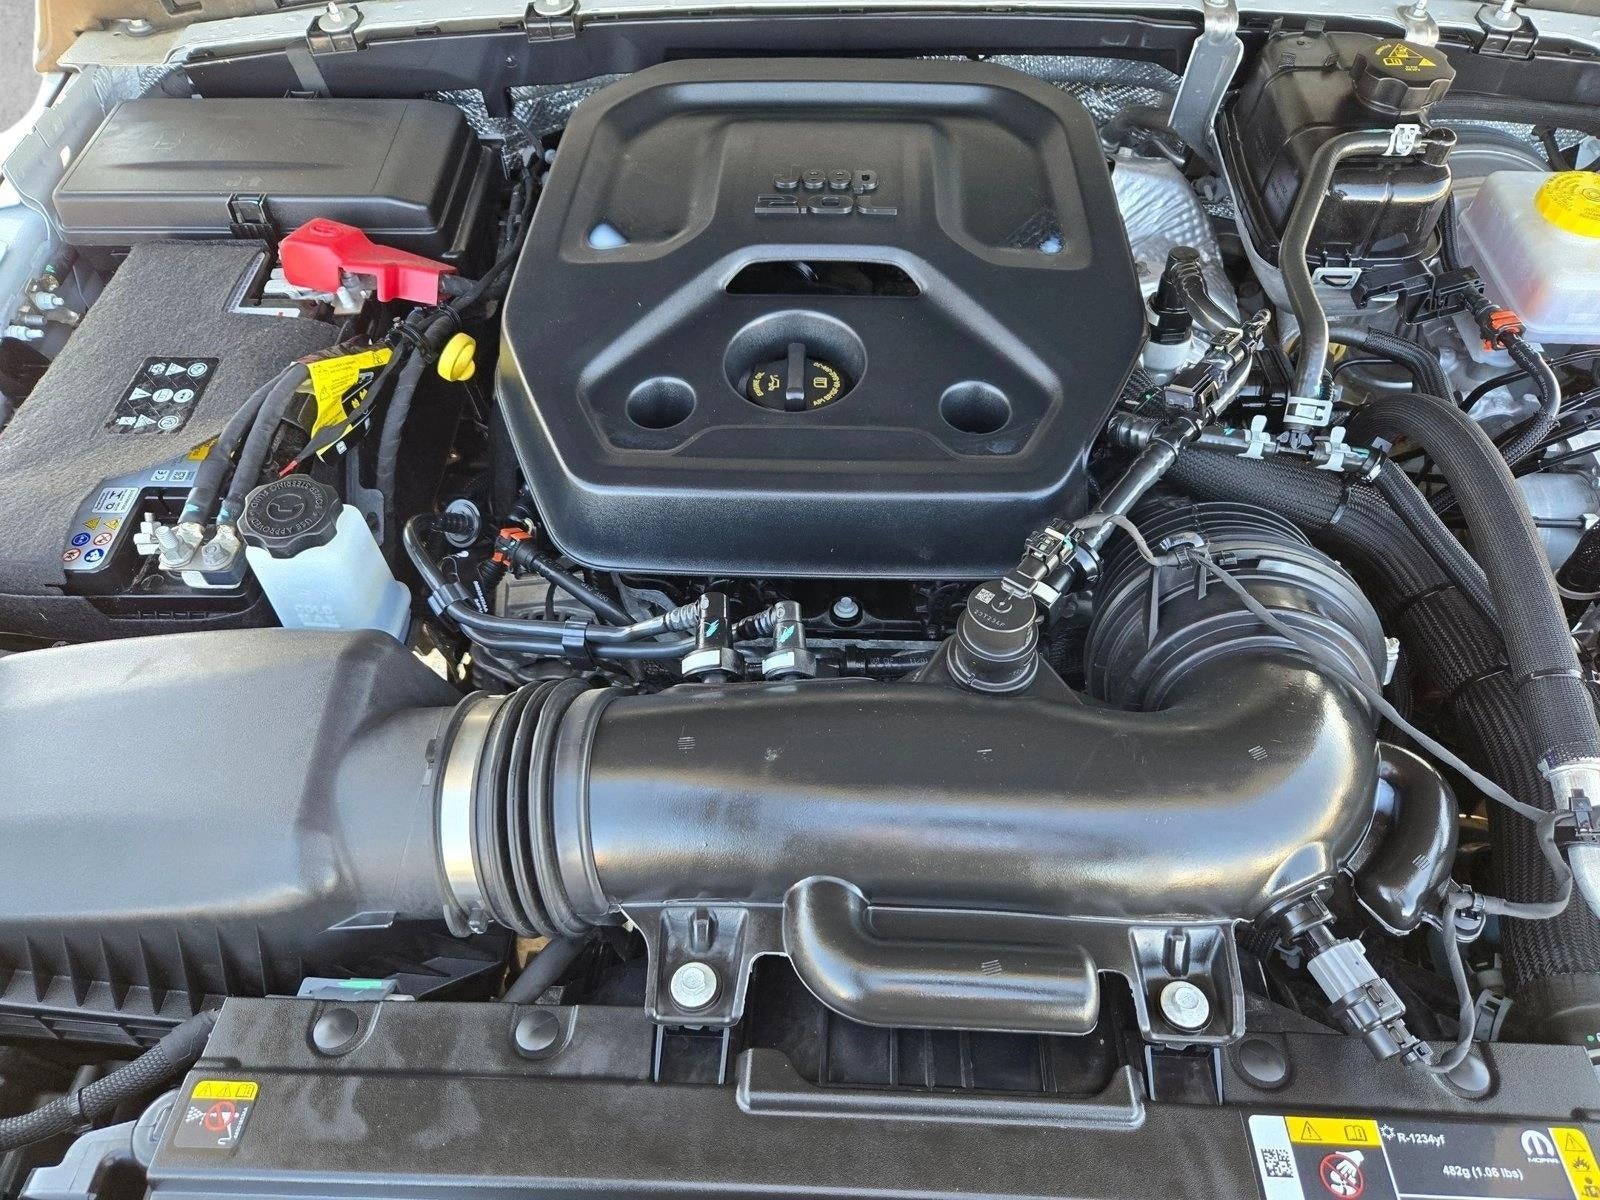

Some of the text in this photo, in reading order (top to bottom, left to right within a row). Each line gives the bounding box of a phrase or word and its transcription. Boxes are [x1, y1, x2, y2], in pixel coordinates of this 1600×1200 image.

[774, 167, 877, 194] Jeep
[755, 194, 897, 215] 2.0L
[251, 518, 312, 535] USE APPROVED
[1397, 1133, 1445, 1147] R-1234yf
[1443, 1165, 1471, 1179] 482g
[1500, 1168, 1523, 1180] lbs)
